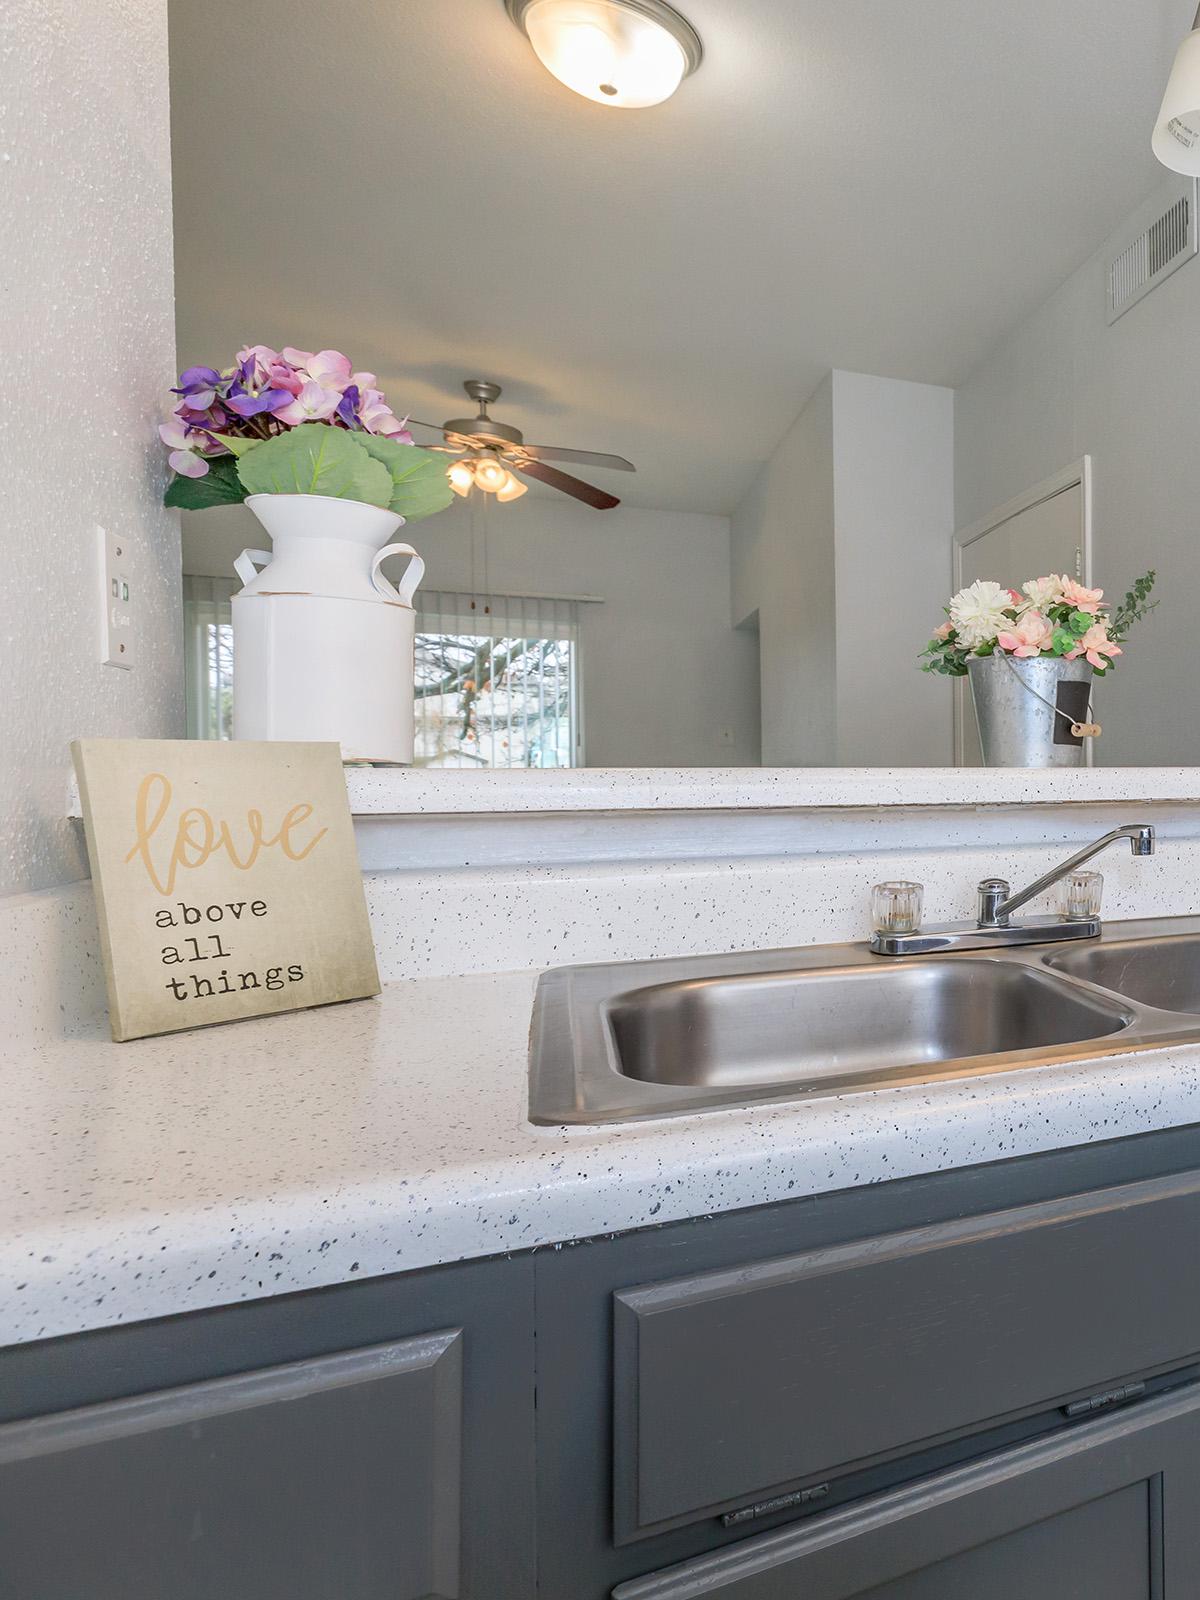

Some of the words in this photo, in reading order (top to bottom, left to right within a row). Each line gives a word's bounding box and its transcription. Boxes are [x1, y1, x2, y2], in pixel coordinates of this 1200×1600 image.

[124, 772, 328, 897] love
[154, 899, 268, 929] above
[160, 934, 232, 965] all
[165, 962, 305, 1001] things
